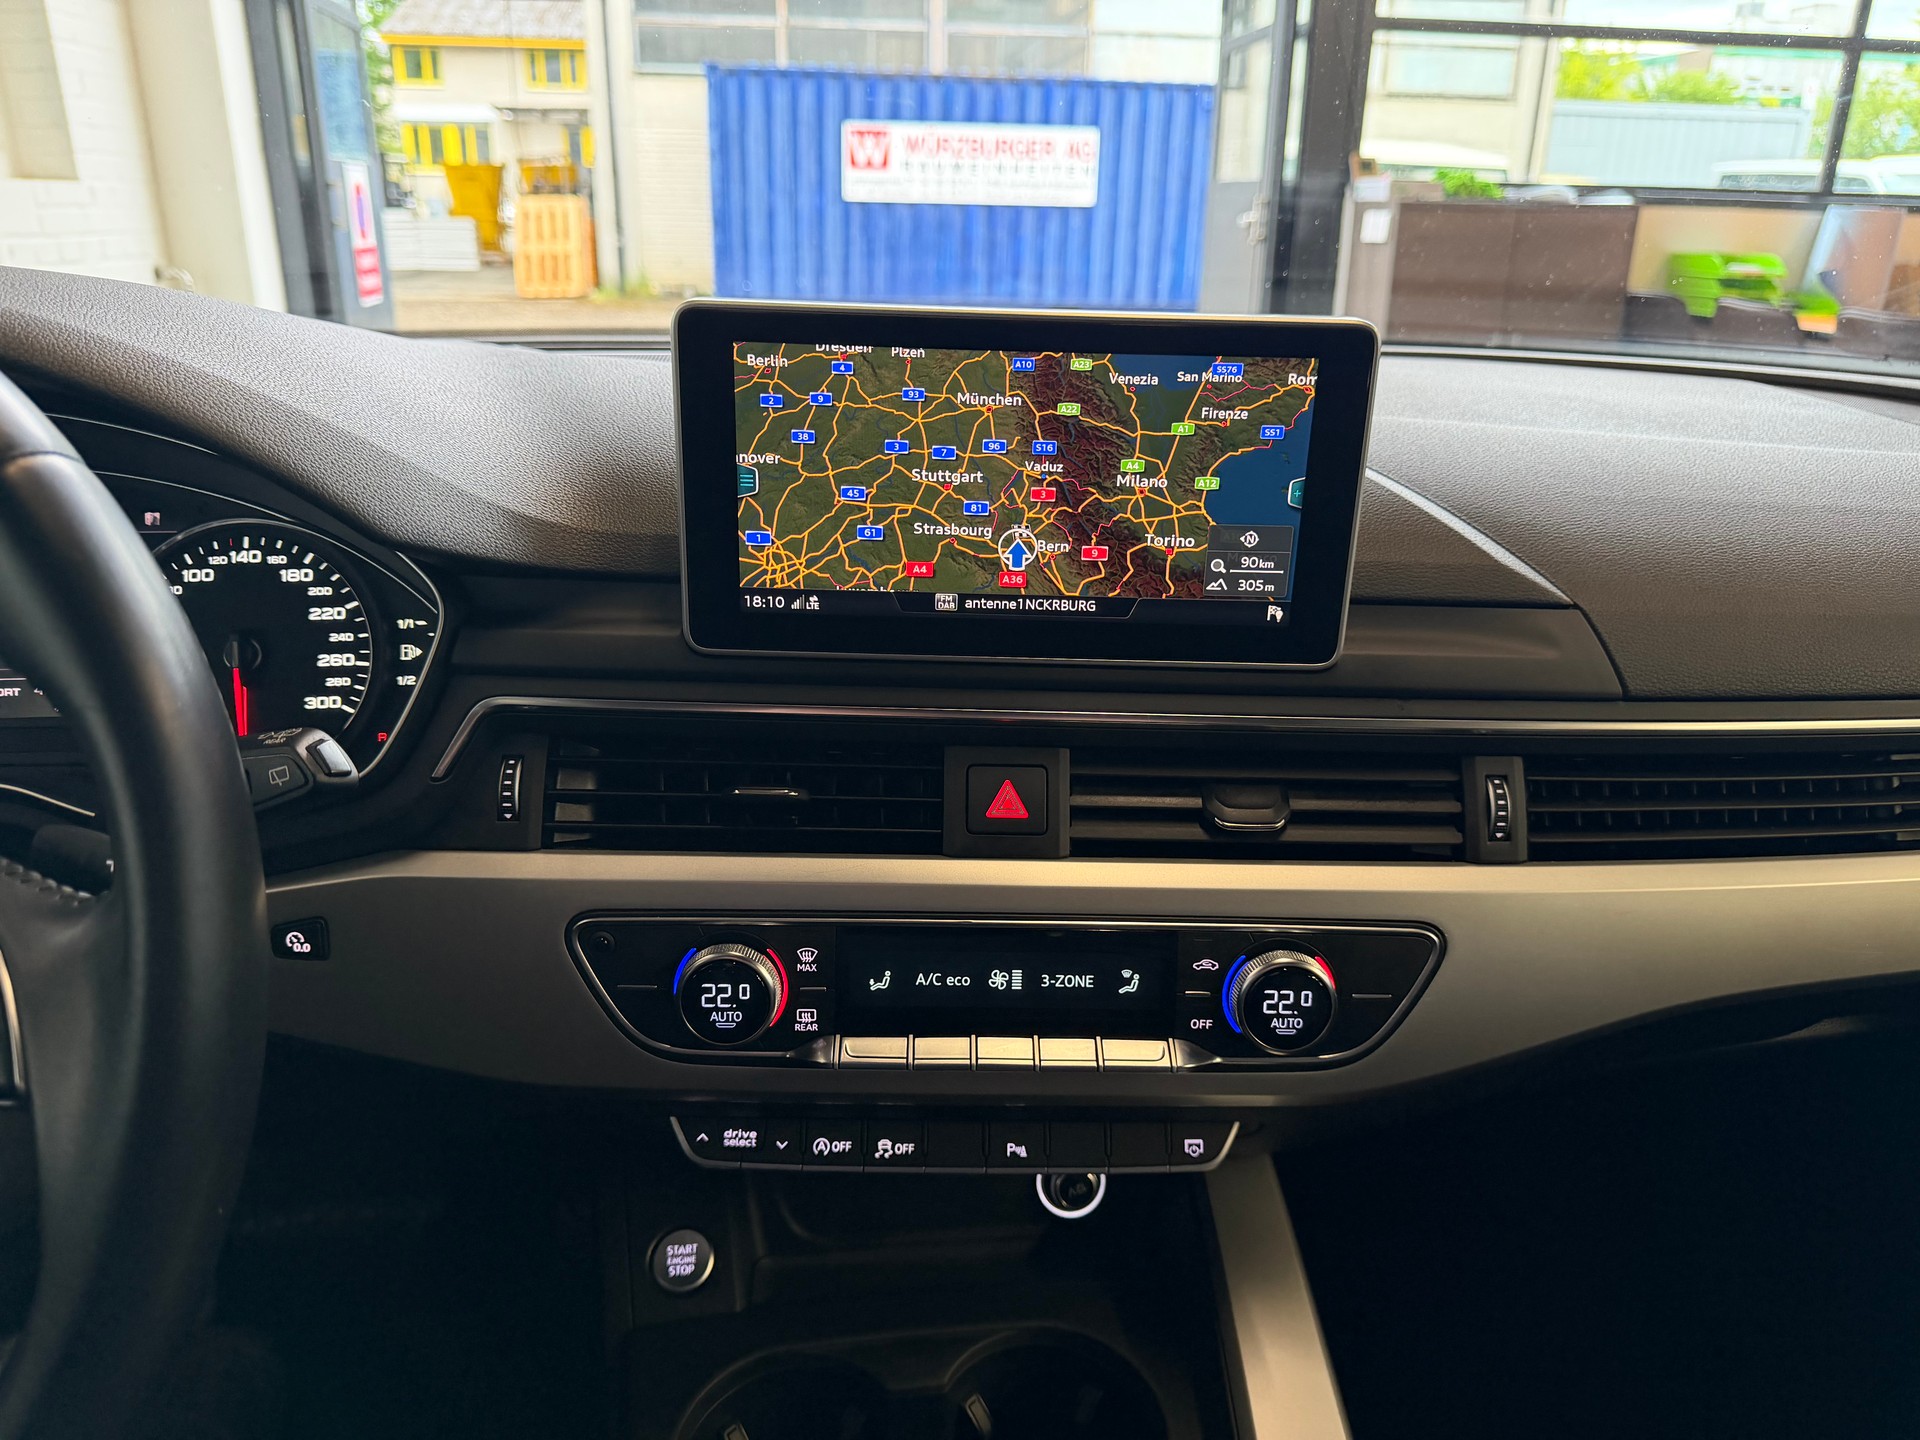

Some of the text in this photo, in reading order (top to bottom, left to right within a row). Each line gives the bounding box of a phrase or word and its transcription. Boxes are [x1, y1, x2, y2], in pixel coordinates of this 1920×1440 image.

[746, 354, 789, 367] Berlin
[1014, 360, 1033, 369] A10
[1072, 360, 1091, 369] A23
[1108, 372, 1160, 386] Venezia
[1176, 370, 1244, 383] San Marino
[907, 389, 920, 399] 93
[957, 391, 1022, 407] München
[1059, 404, 1078, 414] A22
[1201, 407, 1249, 420] Firenze
[1176, 424, 1190, 434] A1
[796, 432, 810, 441] 38
[987, 441, 1001, 451] 96
[1035, 443, 1054, 453] S16
[736, 453, 781, 465] nover
[1024, 460, 1064, 473] Vaduz
[1125, 461, 1140, 471] A4
[911, 468, 984, 486] Stuttgart
[1116, 474, 1168, 488] Milano
[1197, 478, 1218, 489] A12
[846, 489, 860, 498] 45
[969, 503, 983, 513] 81
[863, 527, 877, 538] 61
[913, 522, 993, 540] Strasbourg
[1144, 533, 1195, 548] Torino
[1036, 540, 1070, 553] Bern
[207, 555, 229, 565] 120
[229, 550, 262, 563] 140
[266, 555, 288, 565] 160
[912, 564, 927, 574] A4
[181, 568, 215, 583] 100
[279, 568, 314, 583] 180
[1001, 574, 1024, 585] A36
[307, 586, 333, 596] 200
[744, 595, 785, 609] 18:10
[805, 601, 821, 610] LTE
[308, 607, 347, 621] 220
[396, 618, 415, 630] 1/1
[328, 632, 354, 642] 240
[316, 653, 356, 667] 260
[325, 676, 352, 687] 280
[396, 675, 417, 687] 1/2
[303, 696, 342, 709] 300
[292, 942, 312, 953] 0.0
[797, 963, 818, 972] MAX
[915, 972, 971, 987] A/C eco
[1040, 974, 1095, 988] 3-ZONE
[709, 1011, 743, 1022] AUTO
[794, 1023, 819, 1032] REAR
[1190, 1018, 1214, 1030] OFF
[1270, 1018, 1304, 1029] AUTO
[723, 1128, 758, 1139] drive
[723, 1138, 758, 1148] select
[831, 1141, 852, 1153] OFF
[894, 1143, 915, 1155] OFF
[666, 1242, 699, 1256] START
[666, 1255, 697, 1265] ENGINE
[668, 1264, 696, 1277] STOP
